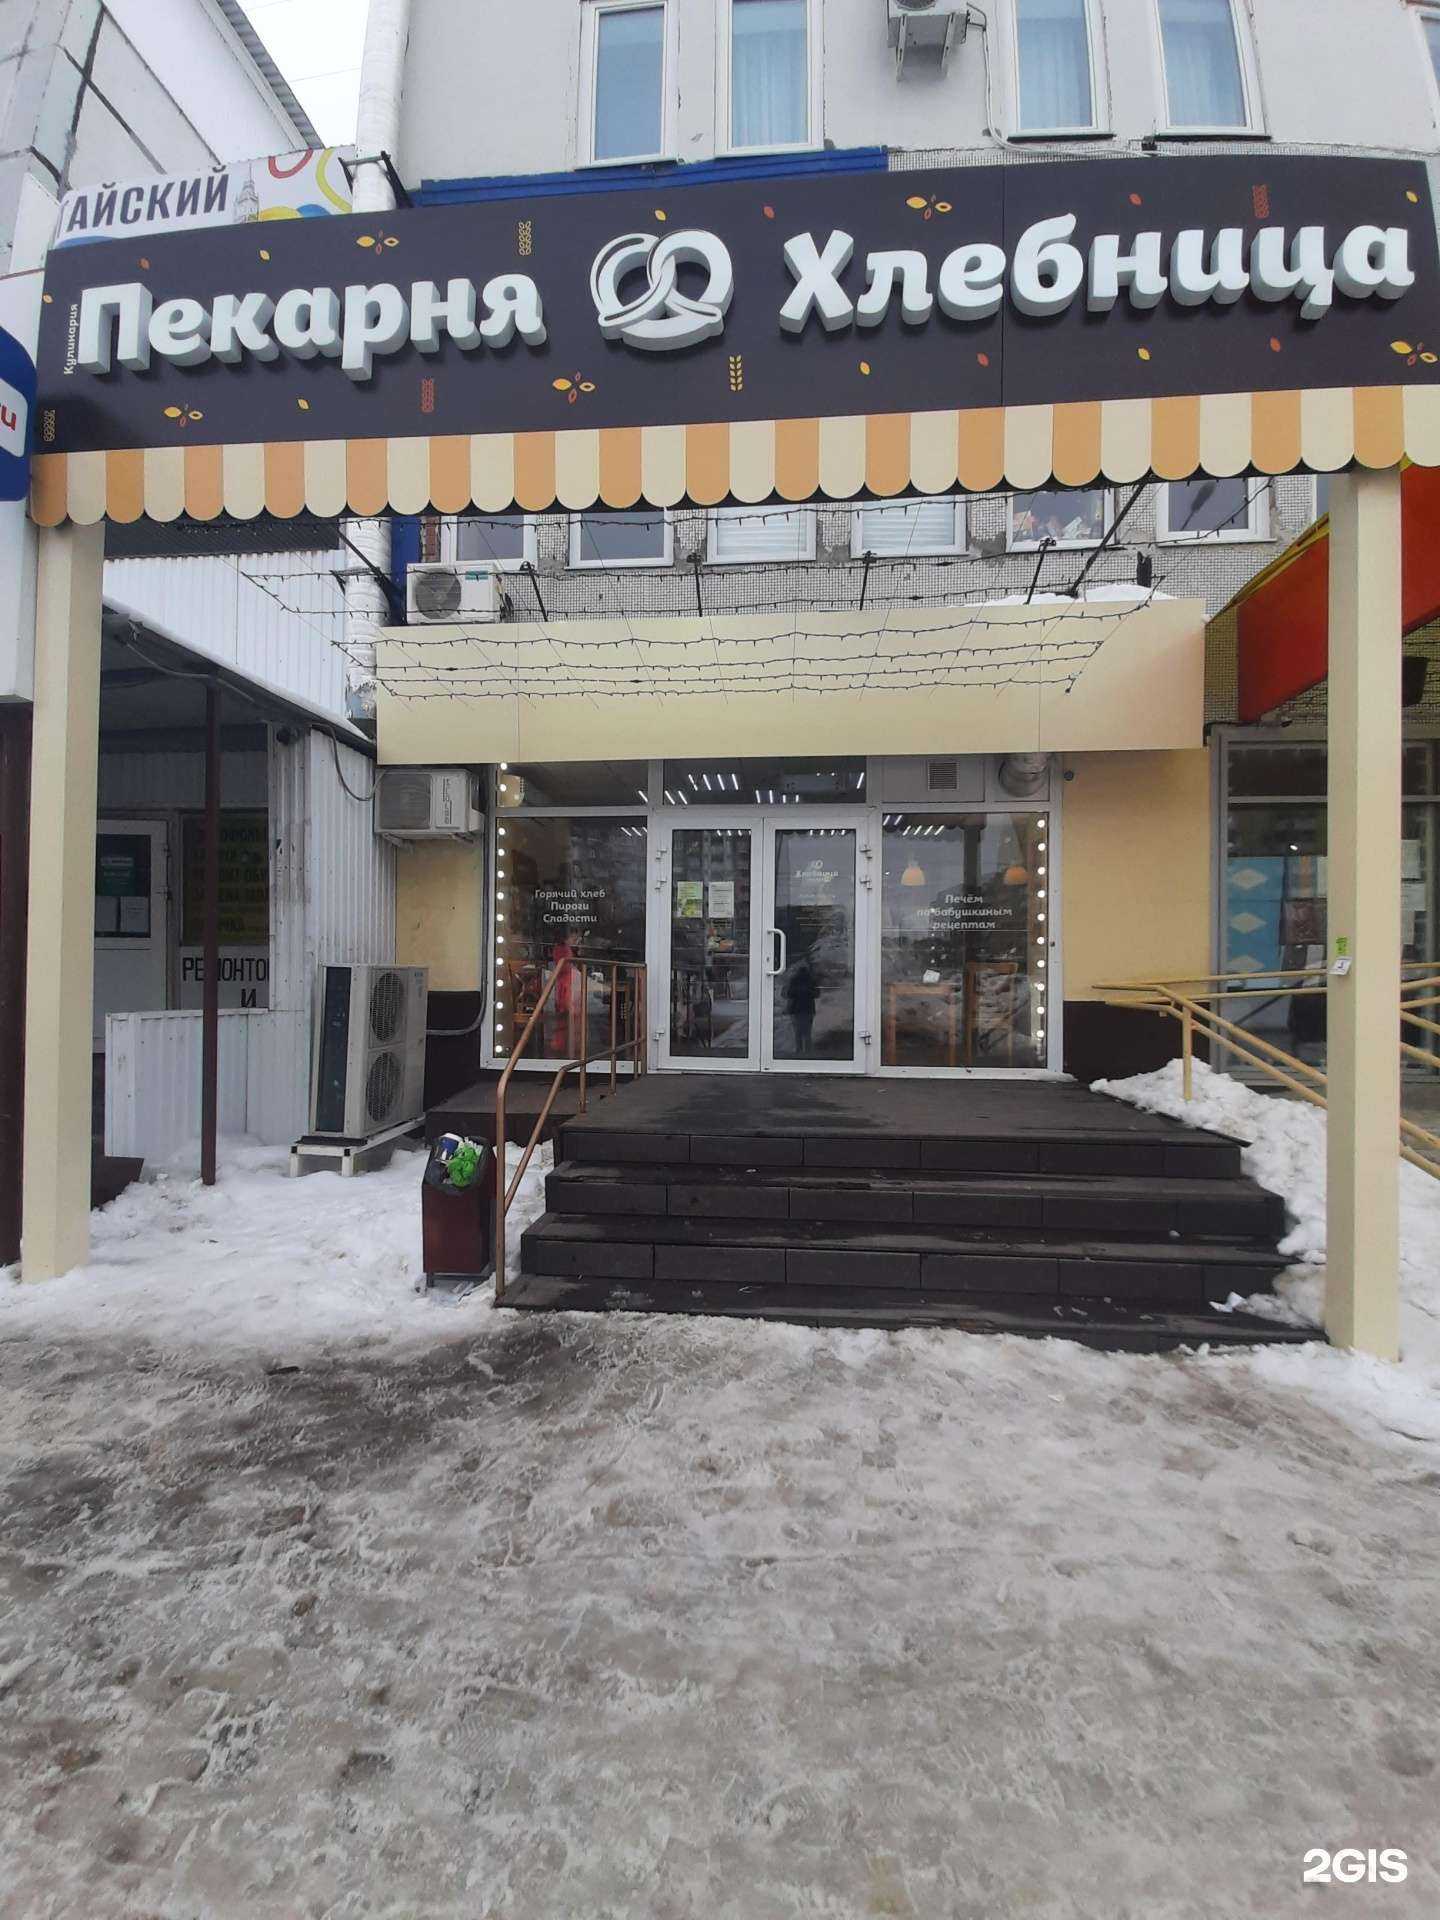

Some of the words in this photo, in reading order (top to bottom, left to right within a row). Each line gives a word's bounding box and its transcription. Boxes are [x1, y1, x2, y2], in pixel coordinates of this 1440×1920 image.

[60, 165, 229, 232] АЙСКИЙ
[78, 271, 547, 381] Пекарня
[779, 213, 1415, 334] Хлебница
[534, 889, 578, 900] Горячий
[580, 888, 606, 898] хлеб
[550, 901, 589, 912] Пироги
[542, 913, 598, 923] Сладости
